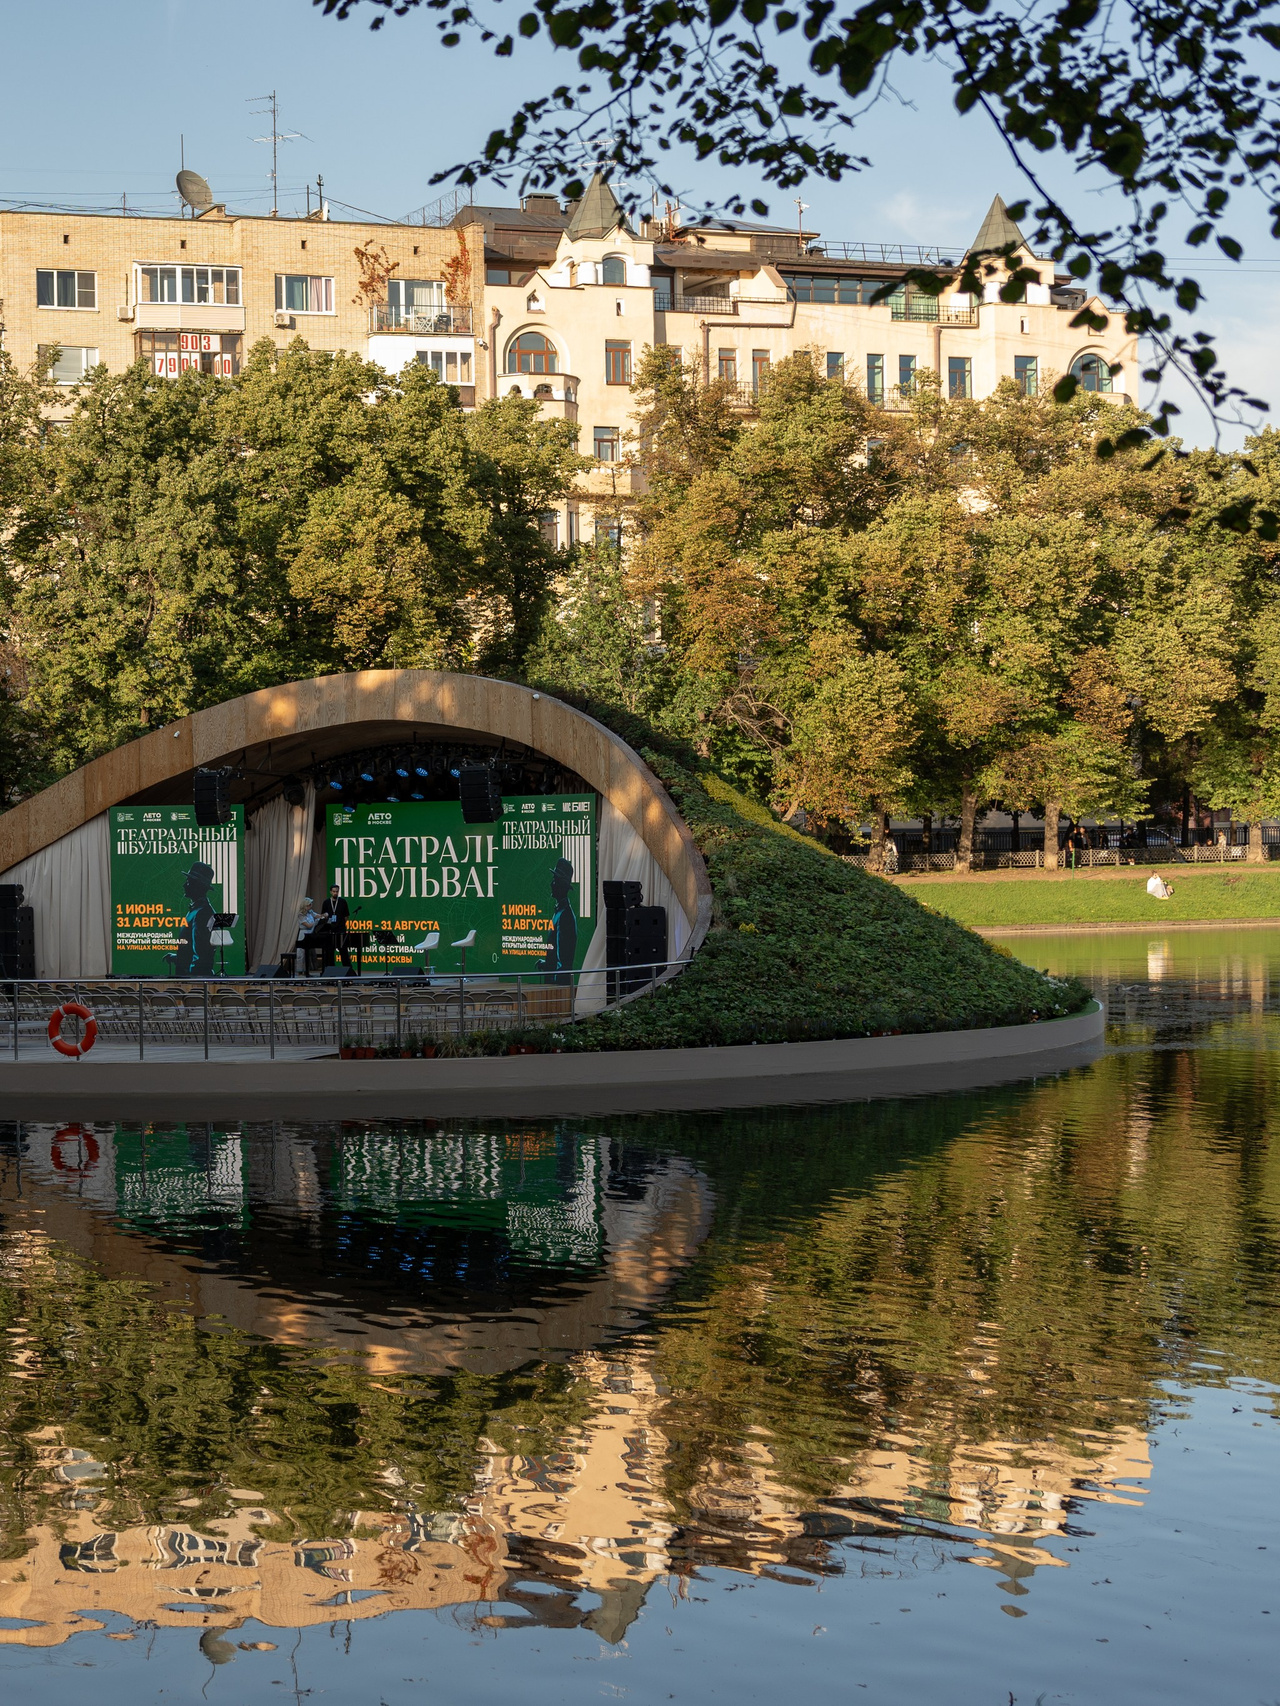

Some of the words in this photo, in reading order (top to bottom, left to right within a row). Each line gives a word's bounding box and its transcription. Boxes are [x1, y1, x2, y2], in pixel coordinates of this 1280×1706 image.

[181, 335, 211, 350] 903
[502, 815, 591, 835] ТЕАТРАЛЬНЫЙ
[117, 823, 237, 841] ТЕАТРАЛЬНЫЙ
[129, 841, 198, 854] БУЛЬВАР
[511, 834, 562, 850] БУЛЬВАР
[116, 904, 123, 914] 1
[126, 904, 164, 914] ИЮНЯ
[501, 904, 507, 915] 1
[508, 904, 536, 916] ИЮНЯ
[116, 917, 131, 928] 31
[133, 917, 189, 928] АВГУСТА
[380, 920, 393, 931] 31
[394, 920, 440, 931] АВГУСТА
[502, 919, 513, 930] 31
[513, 919, 555, 931] АВГУСТА
